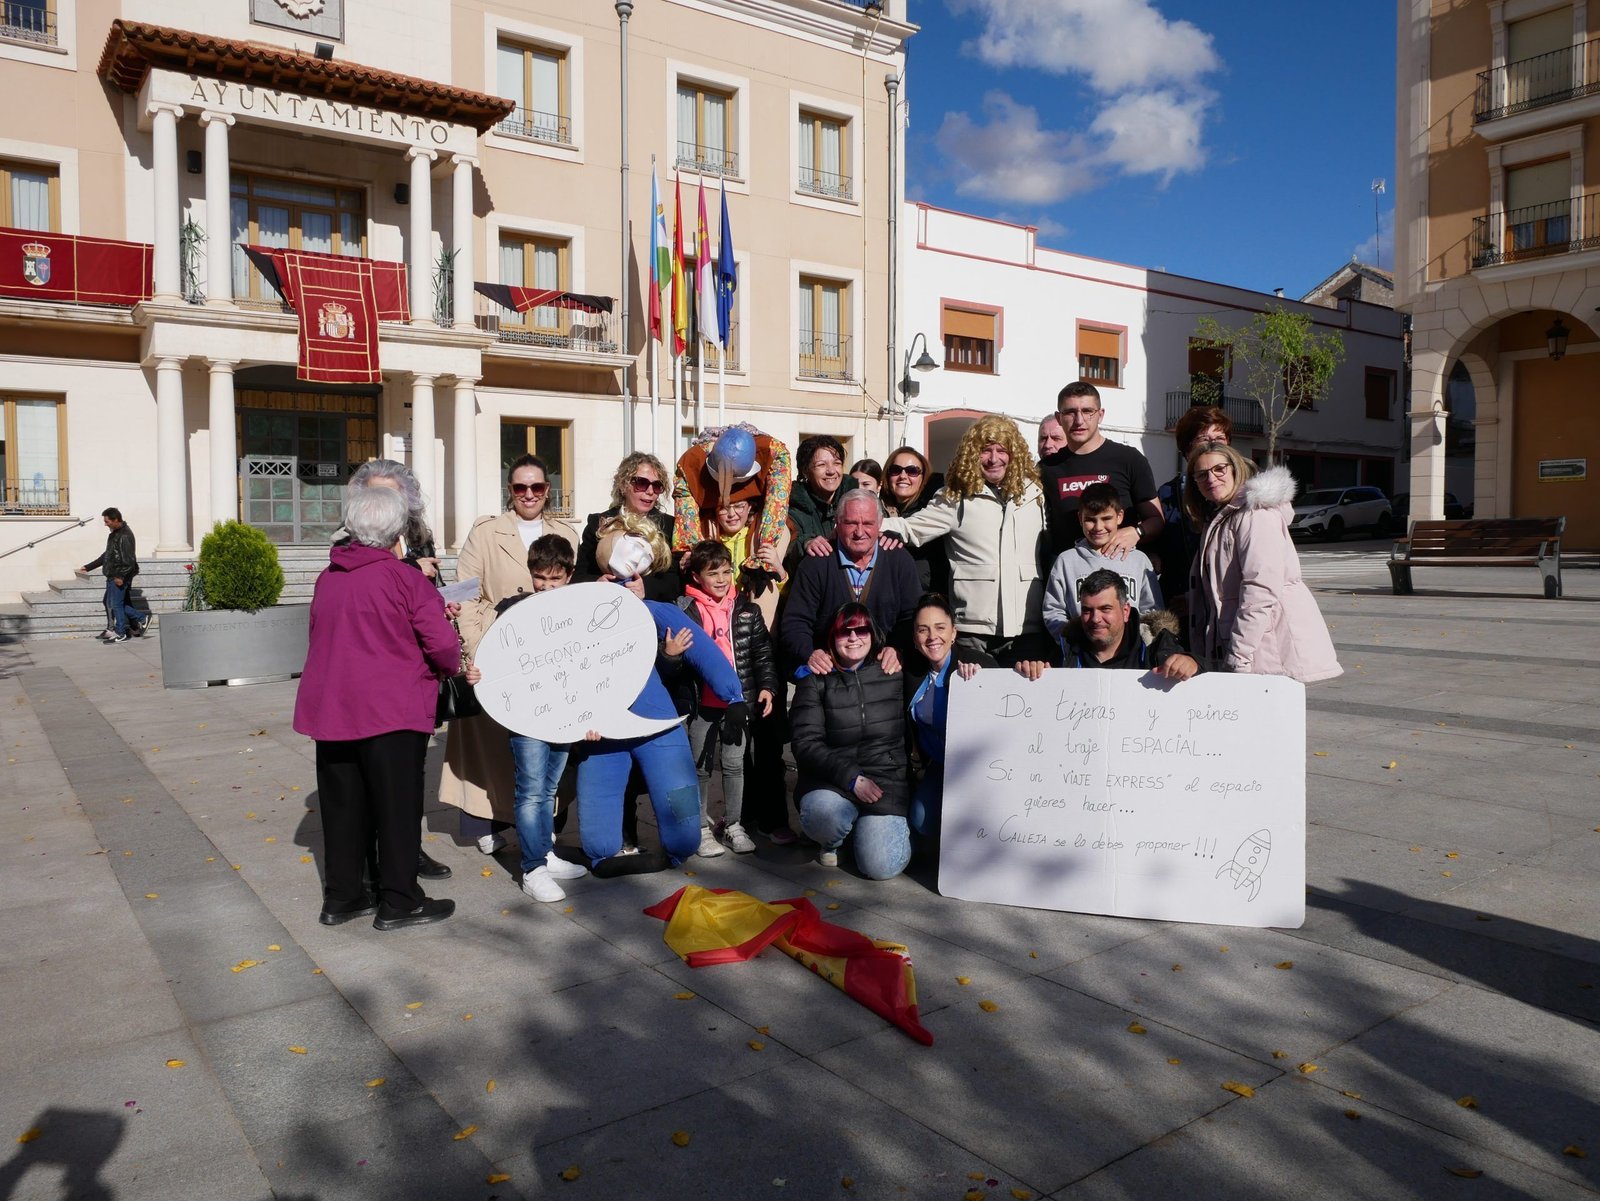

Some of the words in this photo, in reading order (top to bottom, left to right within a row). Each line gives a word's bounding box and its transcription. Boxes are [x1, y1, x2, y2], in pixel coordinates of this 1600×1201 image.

[190, 80, 449, 145] AYUNTAMIENTO
[167, 621, 250, 633] AYUNTAMIENTO
[499, 623, 525, 650] Me
[540, 615, 574, 636] llamo
[502, 691, 512, 712] y
[529, 681, 543, 692] me
[553, 670, 570, 688] voy
[580, 657, 592, 670] al
[600, 641, 637, 668] espacio
[534, 703, 553, 717] con
[595, 677, 610, 694] mi
[994, 693, 1033, 718] De
[1055, 689, 1116, 731] tijeras
[1148, 708, 1160, 731] y
[1186, 704, 1239, 733] peines
[1027, 731, 1044, 754] al
[1065, 731, 1101, 766] traje
[986, 759, 1014, 781] Si
[1029, 772, 1044, 783] un
[1184, 776, 1200, 792] al
[1209, 779, 1262, 799] espacio
[1023, 795, 1067, 818] quieres
[976, 827, 989, 839] a
[1053, 838, 1067, 848] se
[1073, 832, 1087, 848] lo
[1091, 831, 1124, 850] debes
